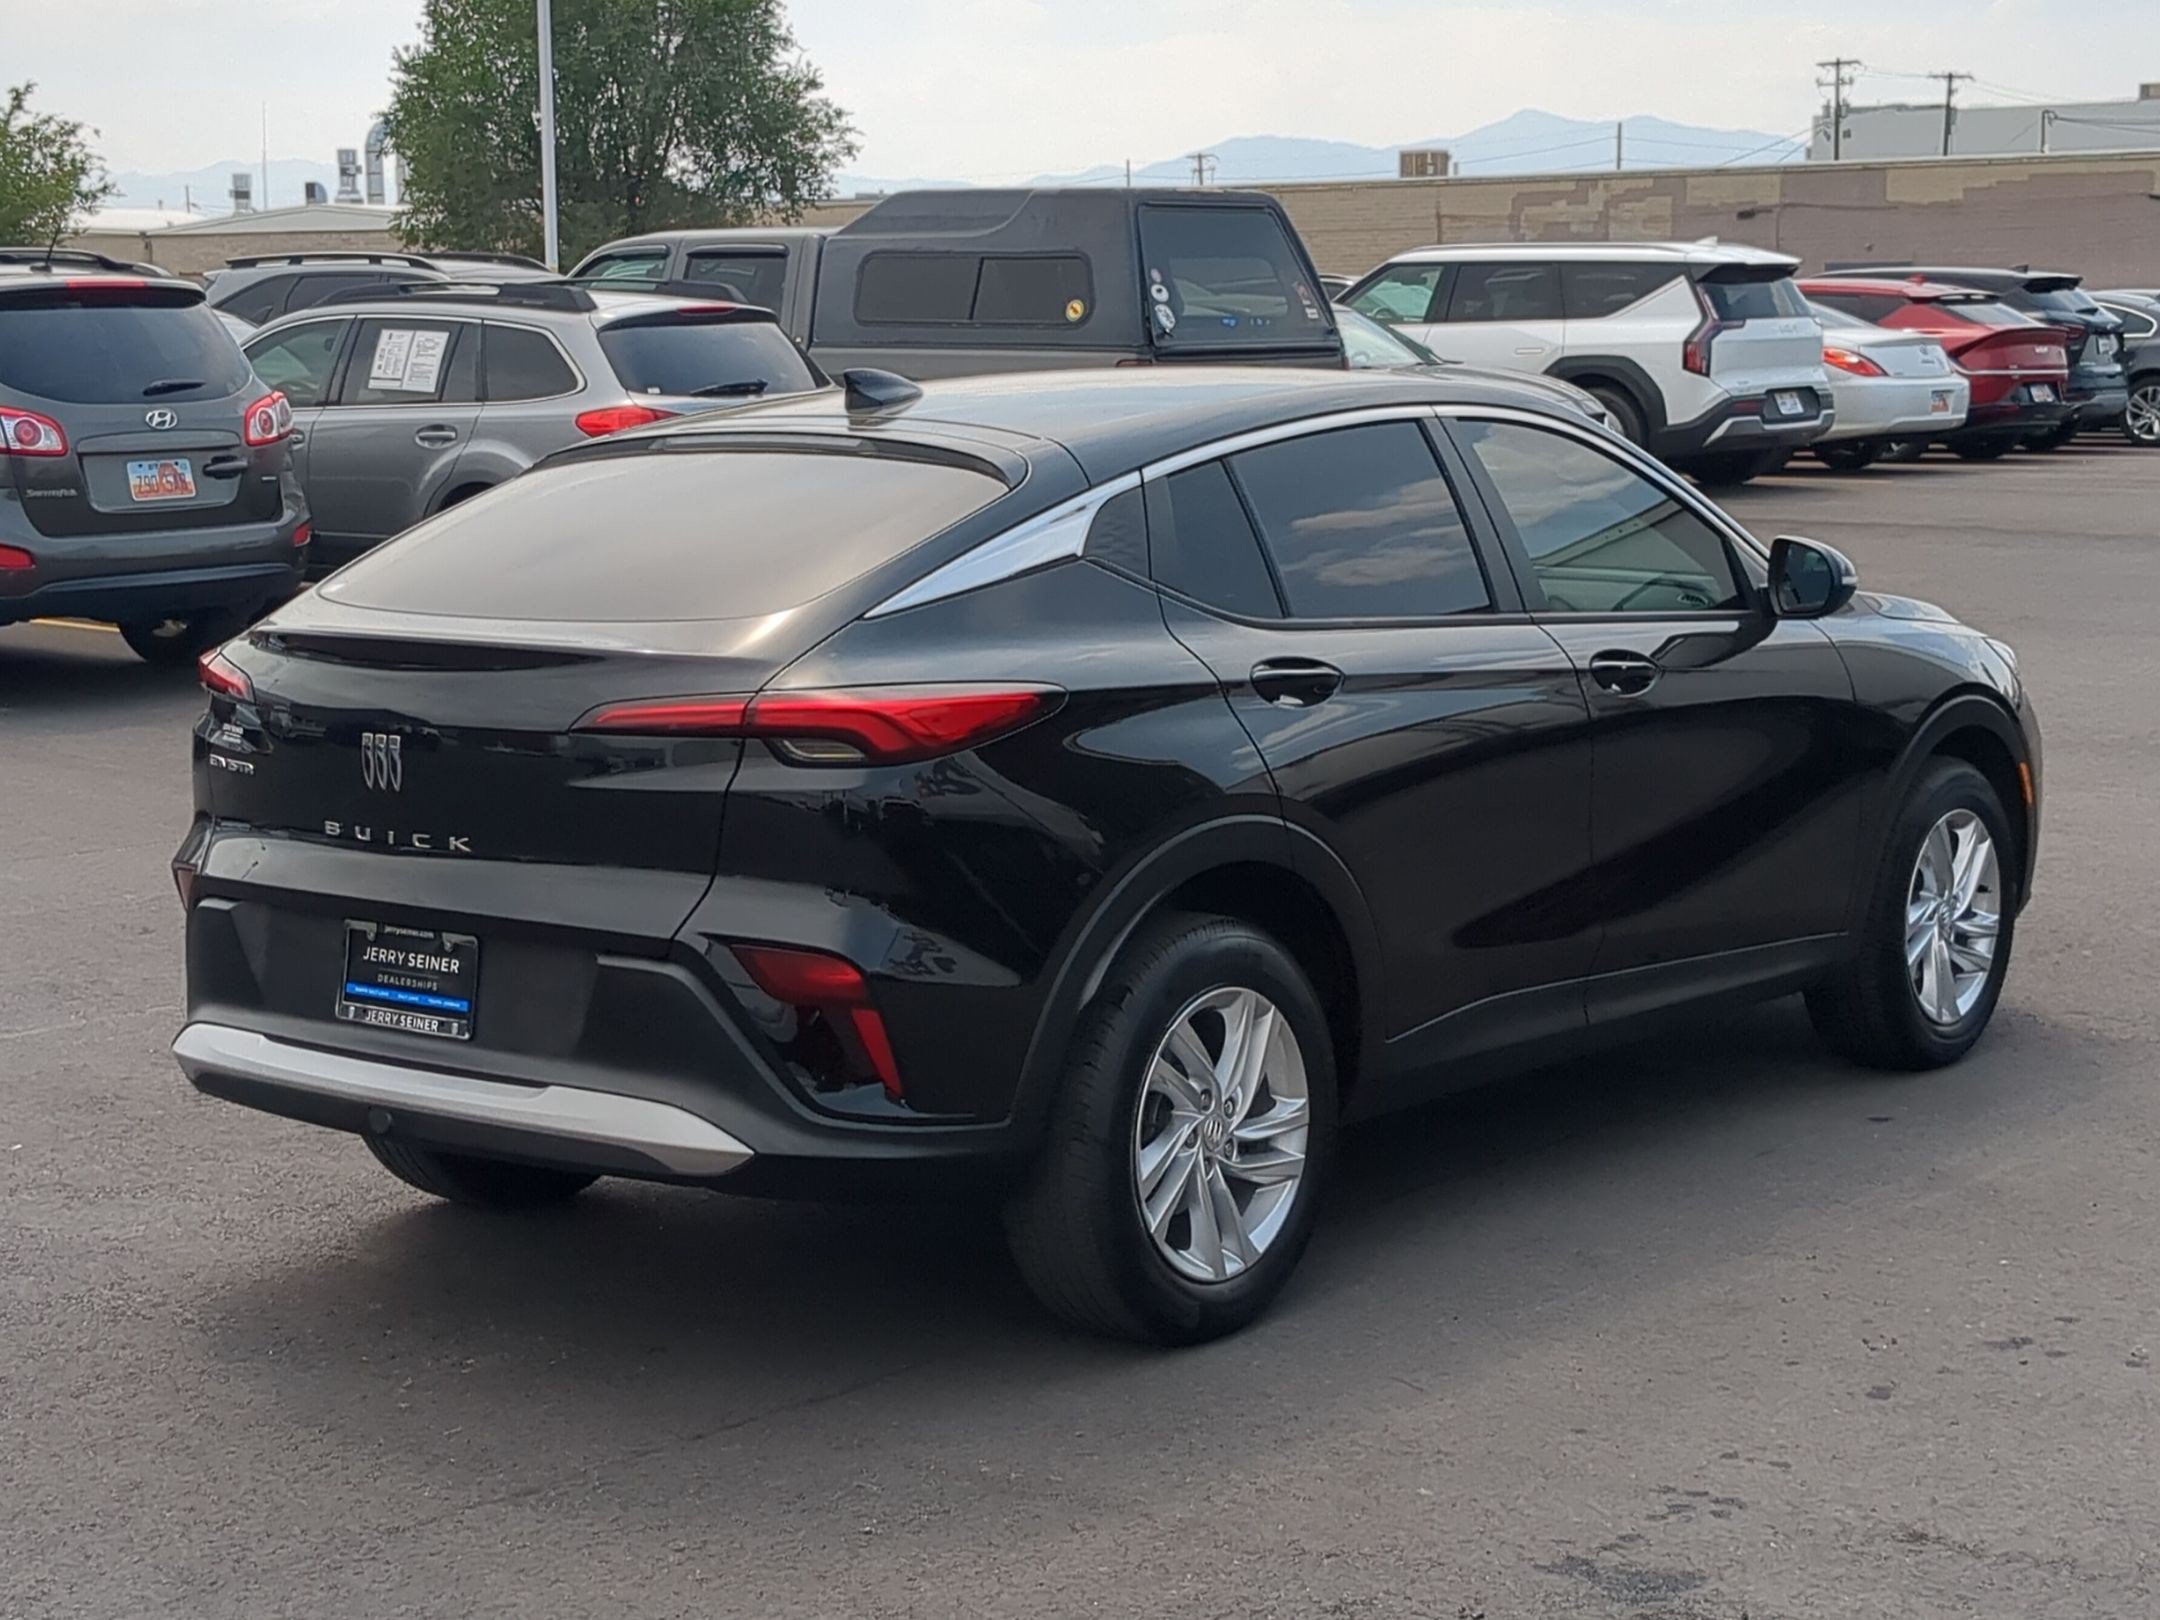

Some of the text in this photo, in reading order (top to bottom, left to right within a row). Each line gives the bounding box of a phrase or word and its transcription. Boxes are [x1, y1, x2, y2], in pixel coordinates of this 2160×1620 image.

[324, 820, 472, 853] BUICK
[363, 946, 460, 974] JERRY SEINER
[377, 974, 438, 992] DEALERSHIPS
[365, 1008, 440, 1032] JERRY SEINER
